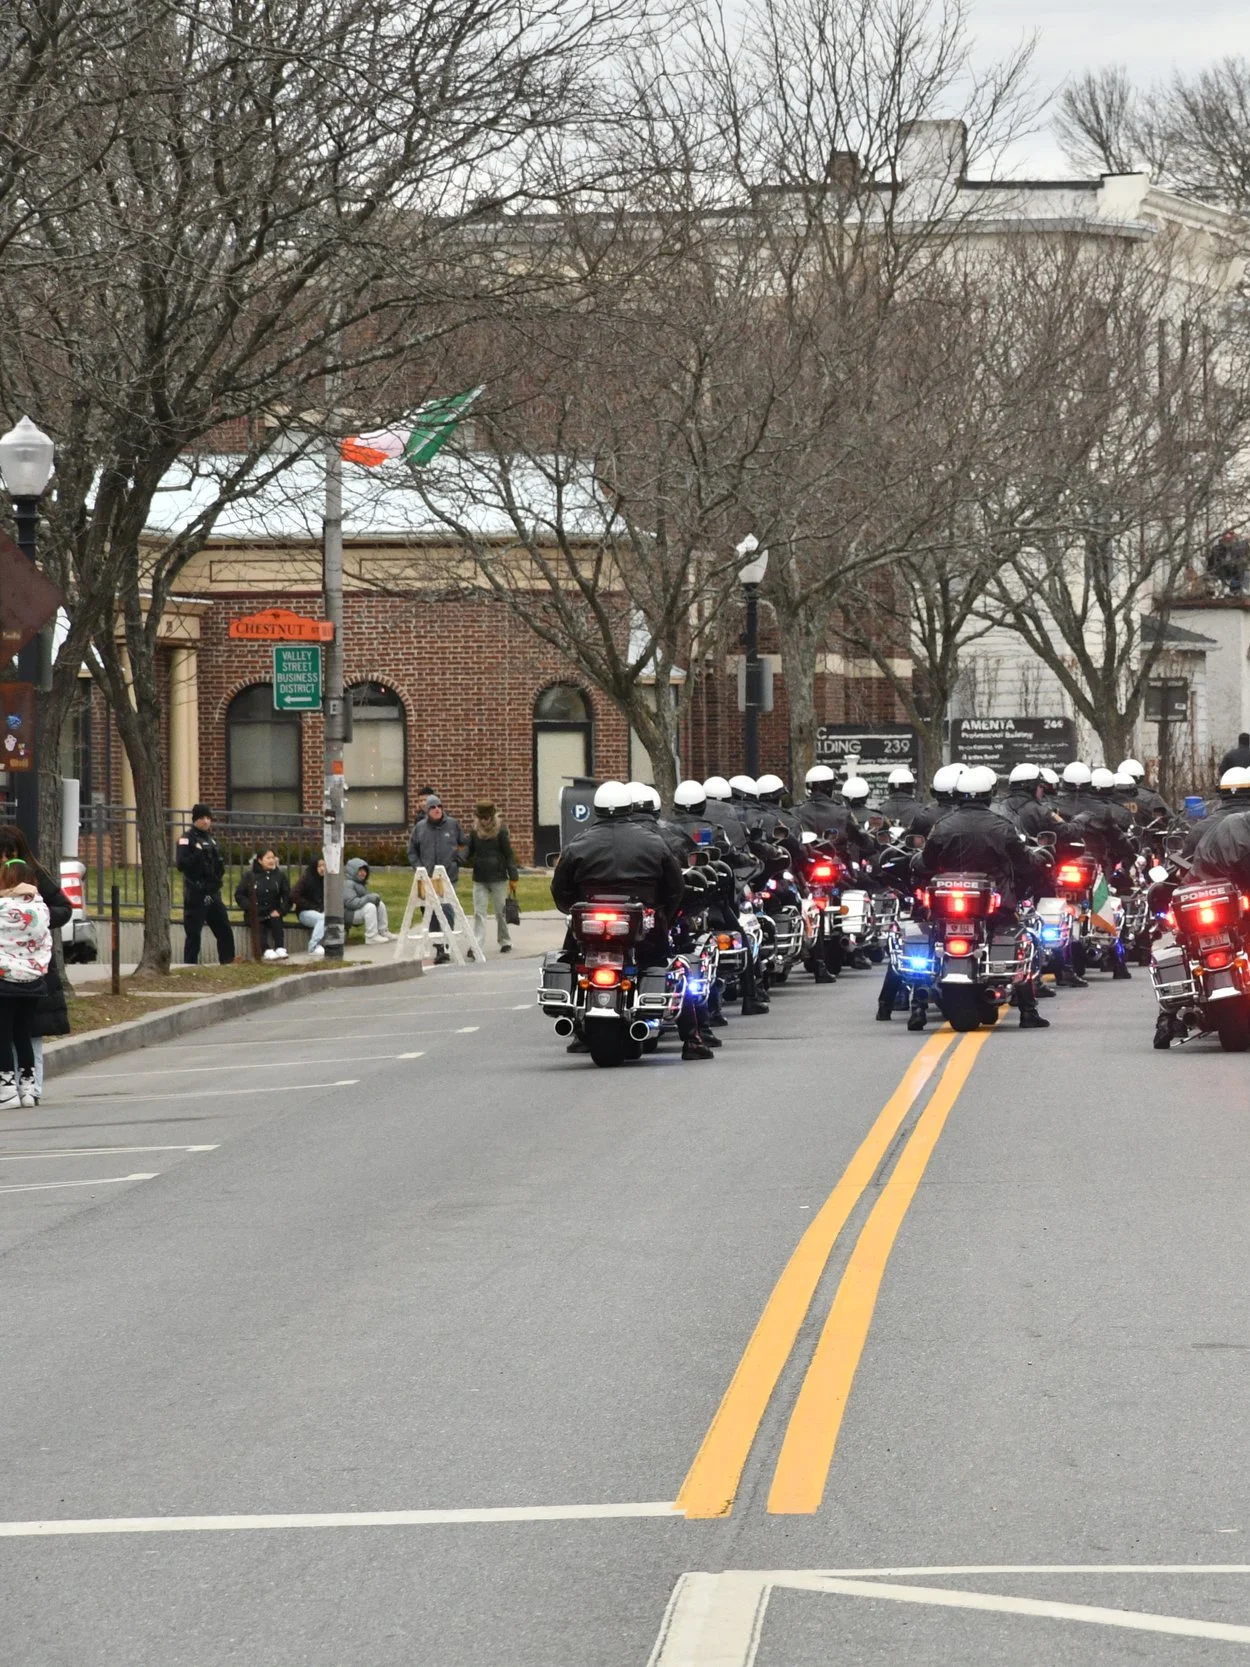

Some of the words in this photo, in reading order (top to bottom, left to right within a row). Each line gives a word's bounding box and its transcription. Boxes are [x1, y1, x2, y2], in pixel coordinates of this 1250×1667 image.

[235, 623, 305, 636] CHESTNUT
[282, 651, 312, 661] VALLEY
[282, 662, 312, 672] STREET
[277, 673, 318, 683] BUSINESS
[280, 684, 315, 694] DISTRICT
[961, 719, 1016, 731] AMENTA
[816, 727, 828, 740] C
[816, 740, 862, 754] LDING
[884, 740, 911, 753] 239
[936, 881, 979, 889] POLICE
[1180, 887, 1226, 902] POLICE
